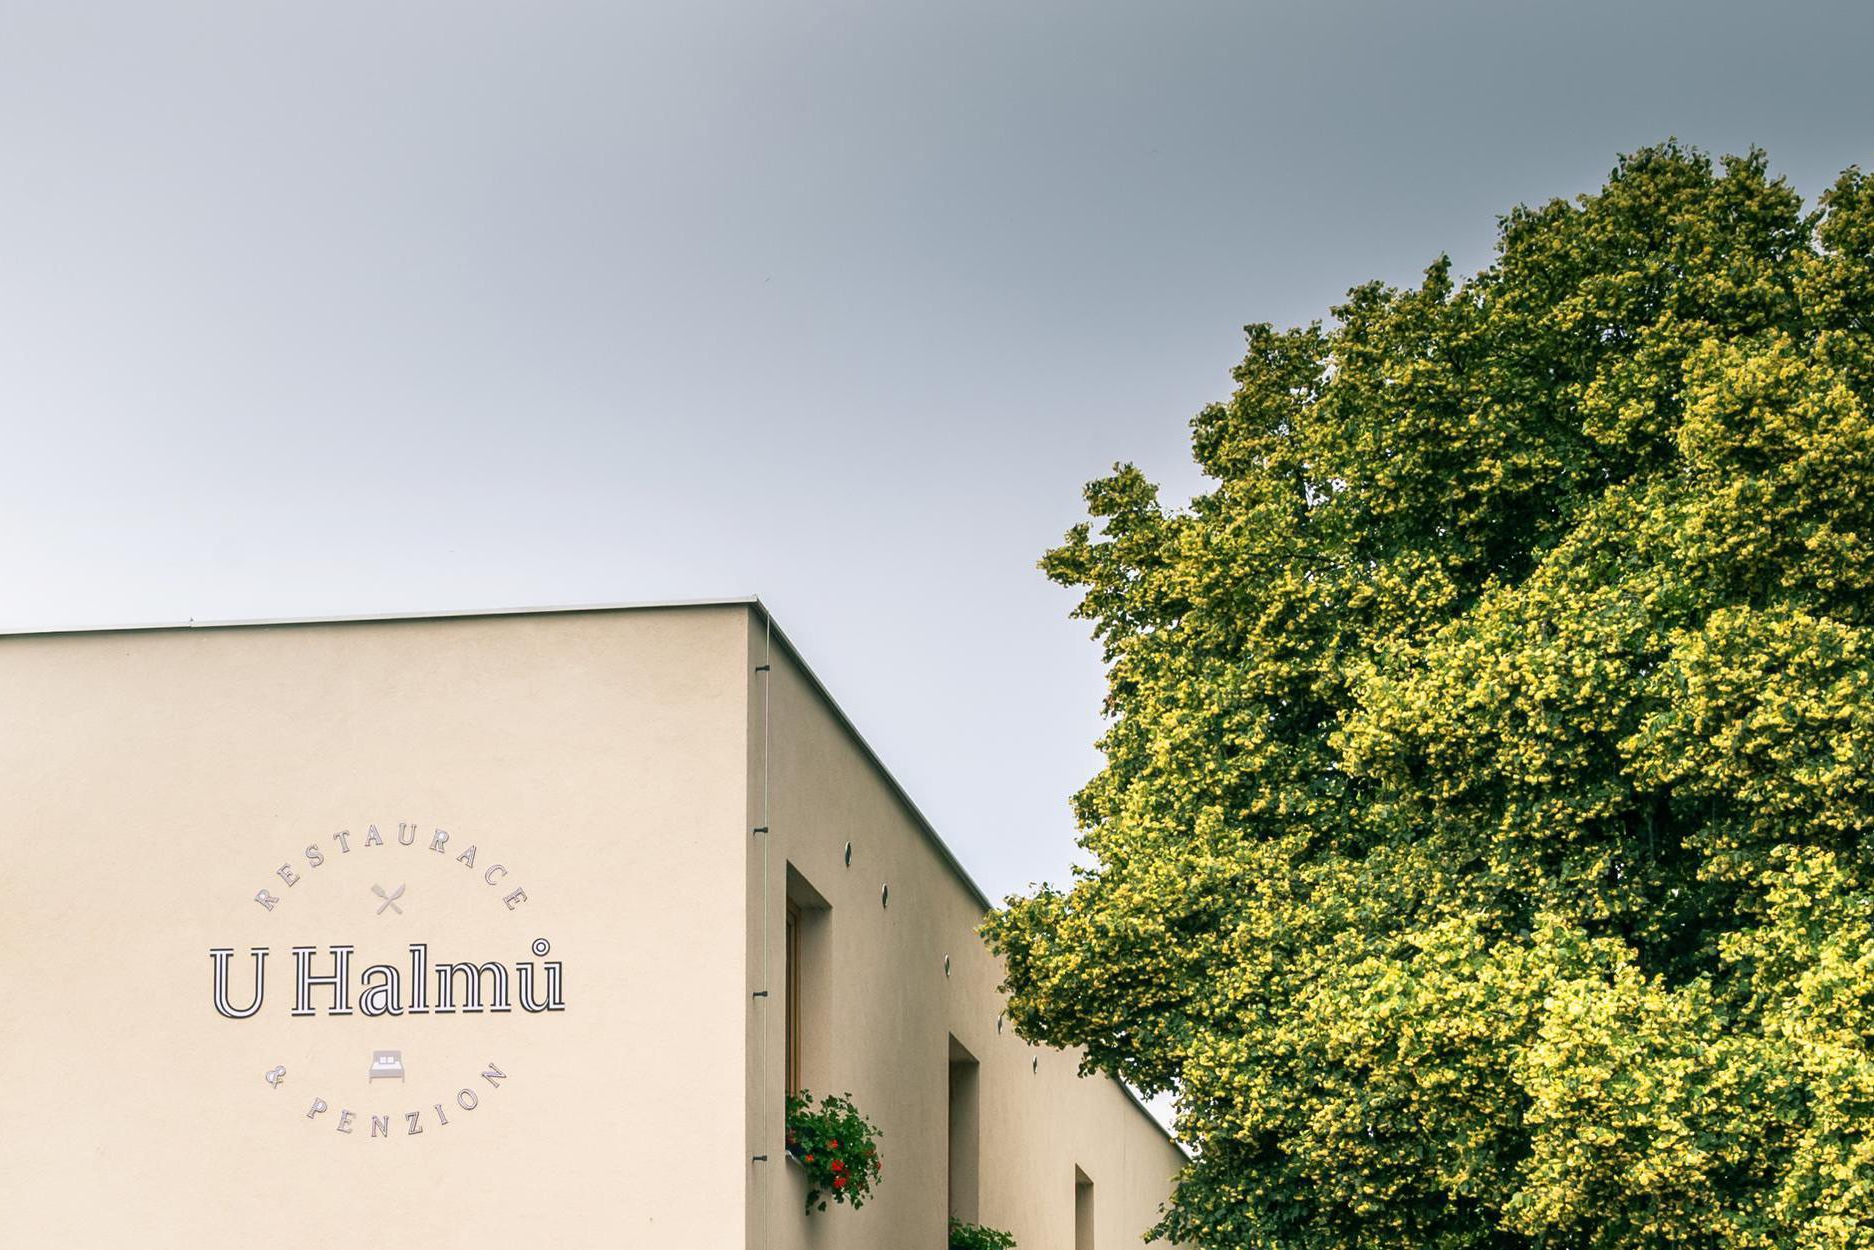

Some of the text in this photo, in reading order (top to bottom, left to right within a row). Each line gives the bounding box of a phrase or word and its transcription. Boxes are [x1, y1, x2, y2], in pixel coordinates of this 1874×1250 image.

[253, 822, 528, 911] RESTAURACE
[209, 938, 566, 1019] U Halmů
[265, 1062, 507, 1138] & PENZION
